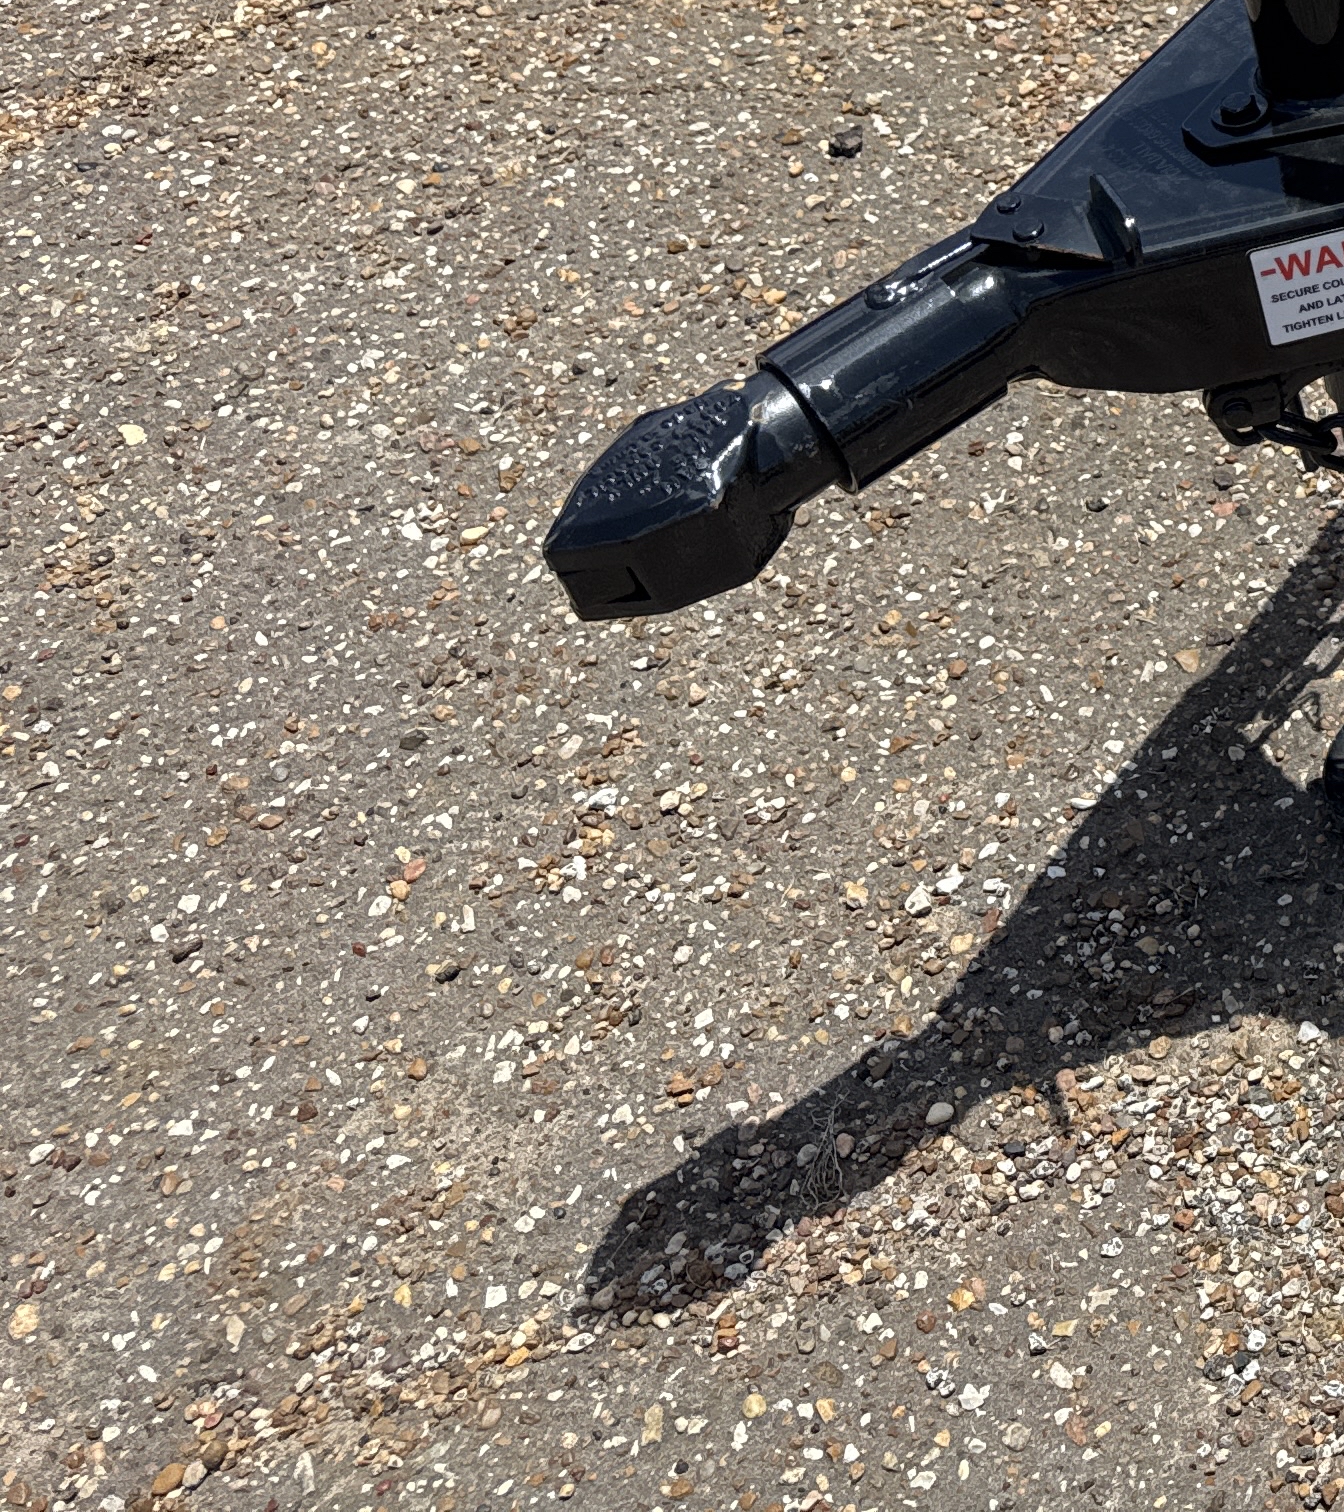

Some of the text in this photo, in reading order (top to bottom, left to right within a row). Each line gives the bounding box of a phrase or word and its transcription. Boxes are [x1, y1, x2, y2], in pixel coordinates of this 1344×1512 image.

[1270, 283, 1321, 304] SECURE
[1298, 299, 1325, 314] AND
[1282, 313, 1335, 334] TIGHTEN
